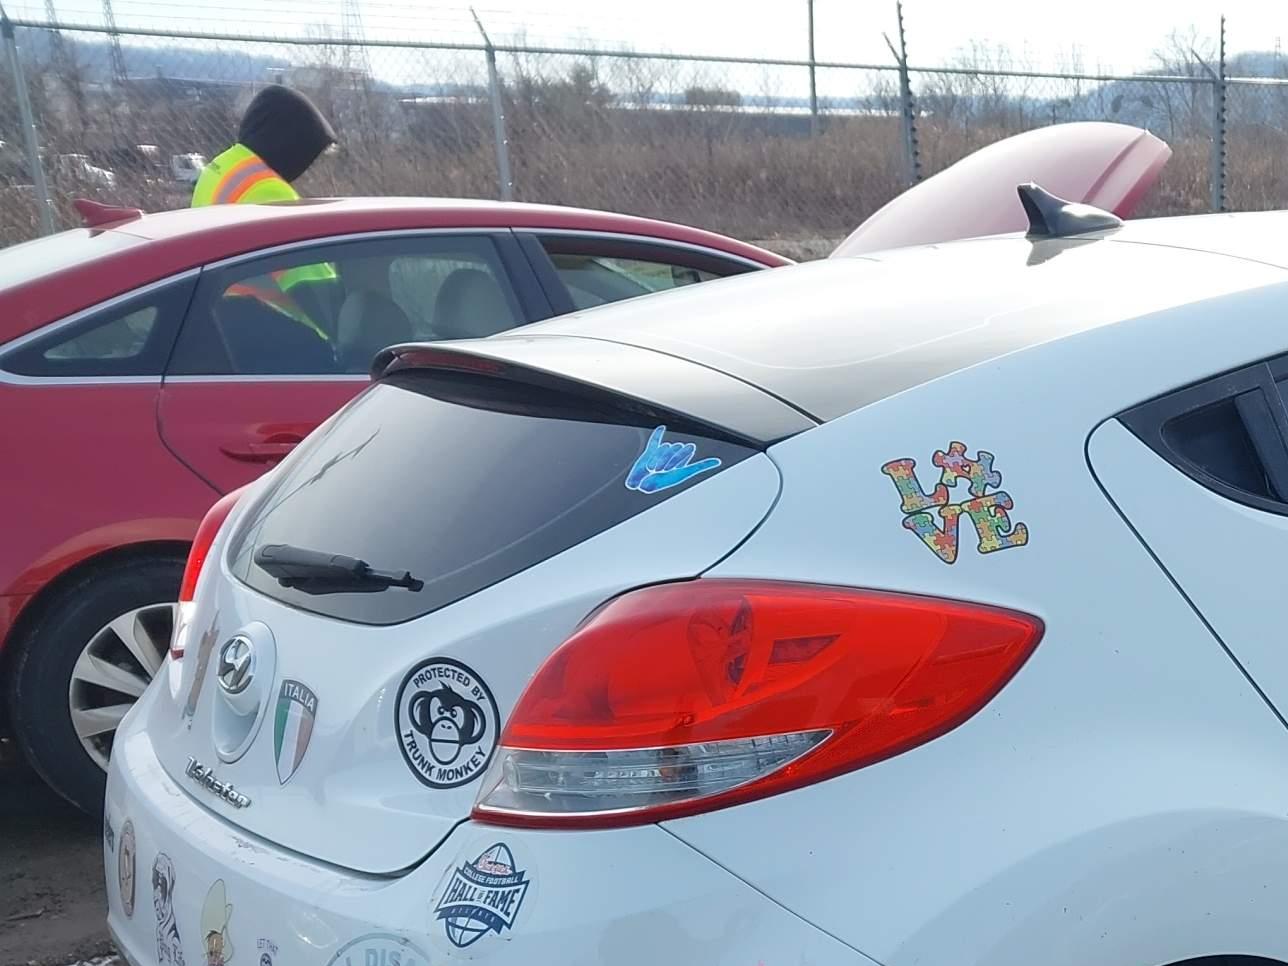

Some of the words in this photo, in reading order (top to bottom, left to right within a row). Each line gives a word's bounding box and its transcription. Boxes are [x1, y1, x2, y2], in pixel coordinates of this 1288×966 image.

[284, 683, 315, 712] ITALIA
[413, 667, 471, 689] PROTECTED
[471, 685, 487, 701] BY
[404, 730, 436, 777] TRUNK
[436, 745, 487, 781] MONKEY
[443, 877, 478, 905] HALL
[483, 887, 521, 919] FAME
